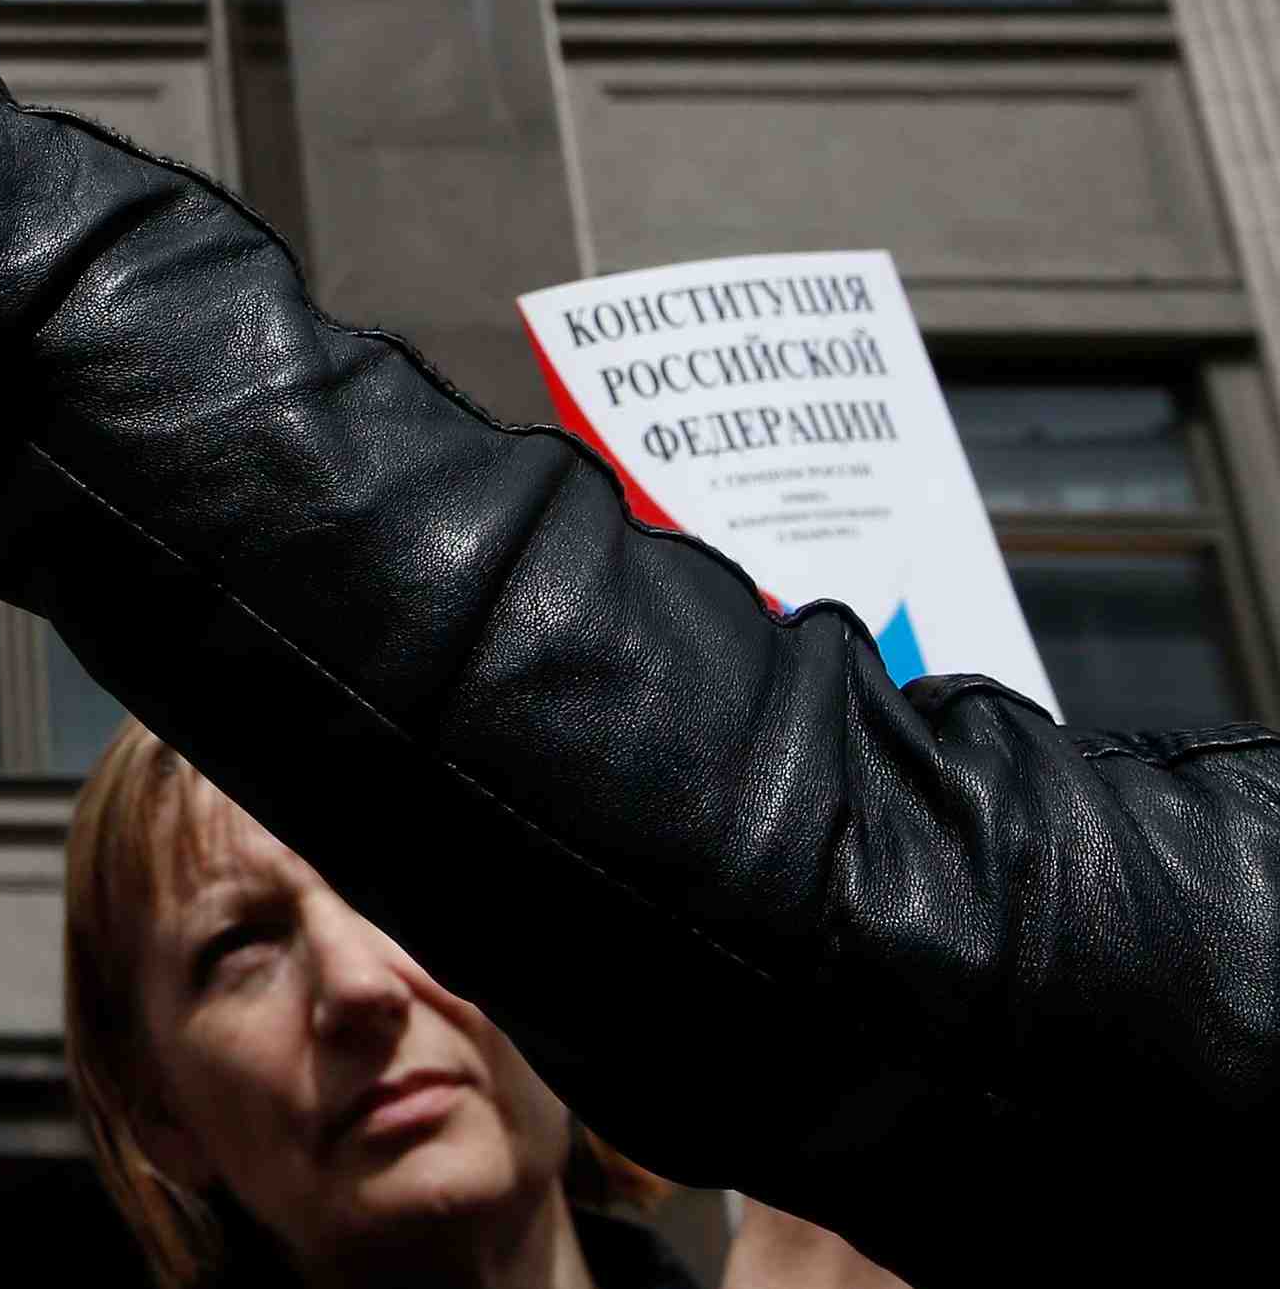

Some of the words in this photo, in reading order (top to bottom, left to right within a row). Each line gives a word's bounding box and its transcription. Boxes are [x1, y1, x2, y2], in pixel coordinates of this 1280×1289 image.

[563, 276, 874, 348] КОНСТИТУЦИЯ
[599, 329, 888, 407] РОССИЙСКОЙ
[643, 401, 897, 462] ФЕДЕРАЦИИ
